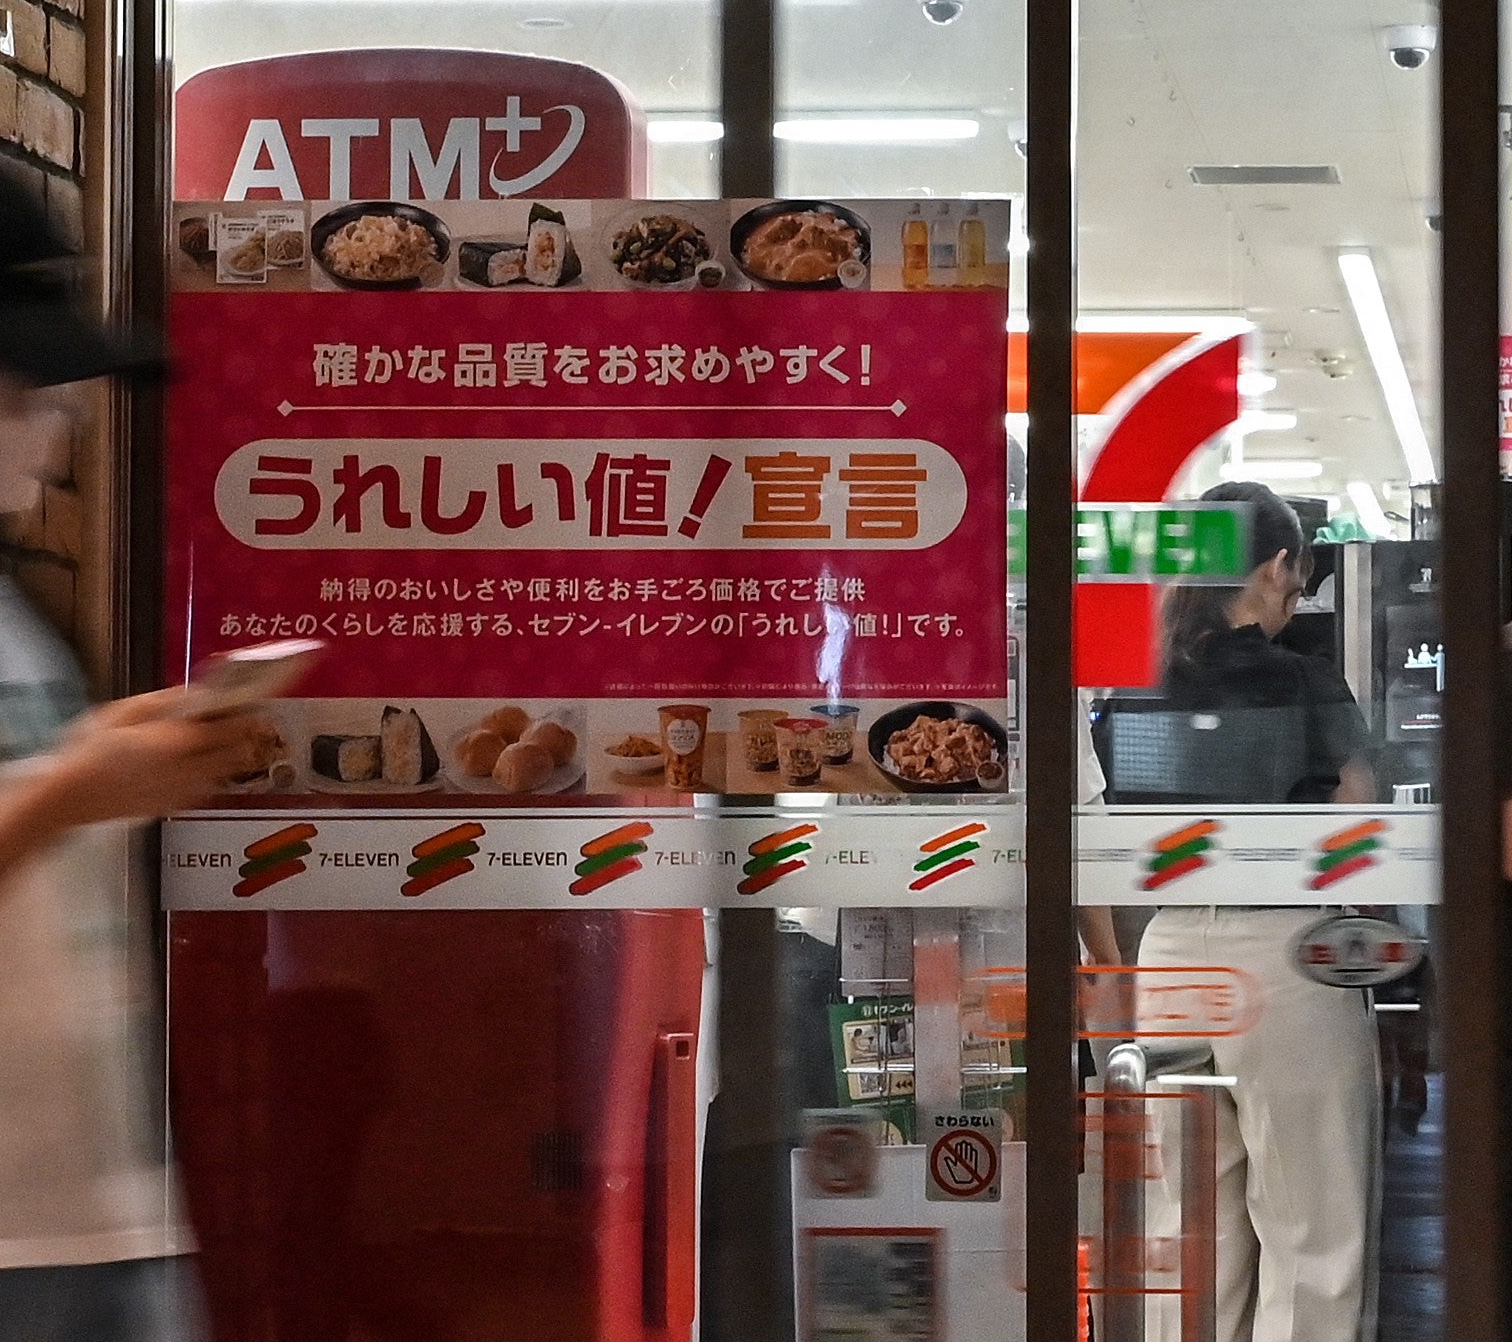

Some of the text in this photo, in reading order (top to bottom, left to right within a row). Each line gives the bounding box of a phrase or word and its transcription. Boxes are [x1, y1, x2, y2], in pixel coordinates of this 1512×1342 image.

[313, 342, 873, 388] 確かな品質をお求めやすく!
[247, 451, 929, 540] うれしい値!宣言
[319, 576, 867, 604] 納得のおいしさや便利をお手ごろ価格でご提供
[934, 1115, 995, 1128] さわらない
